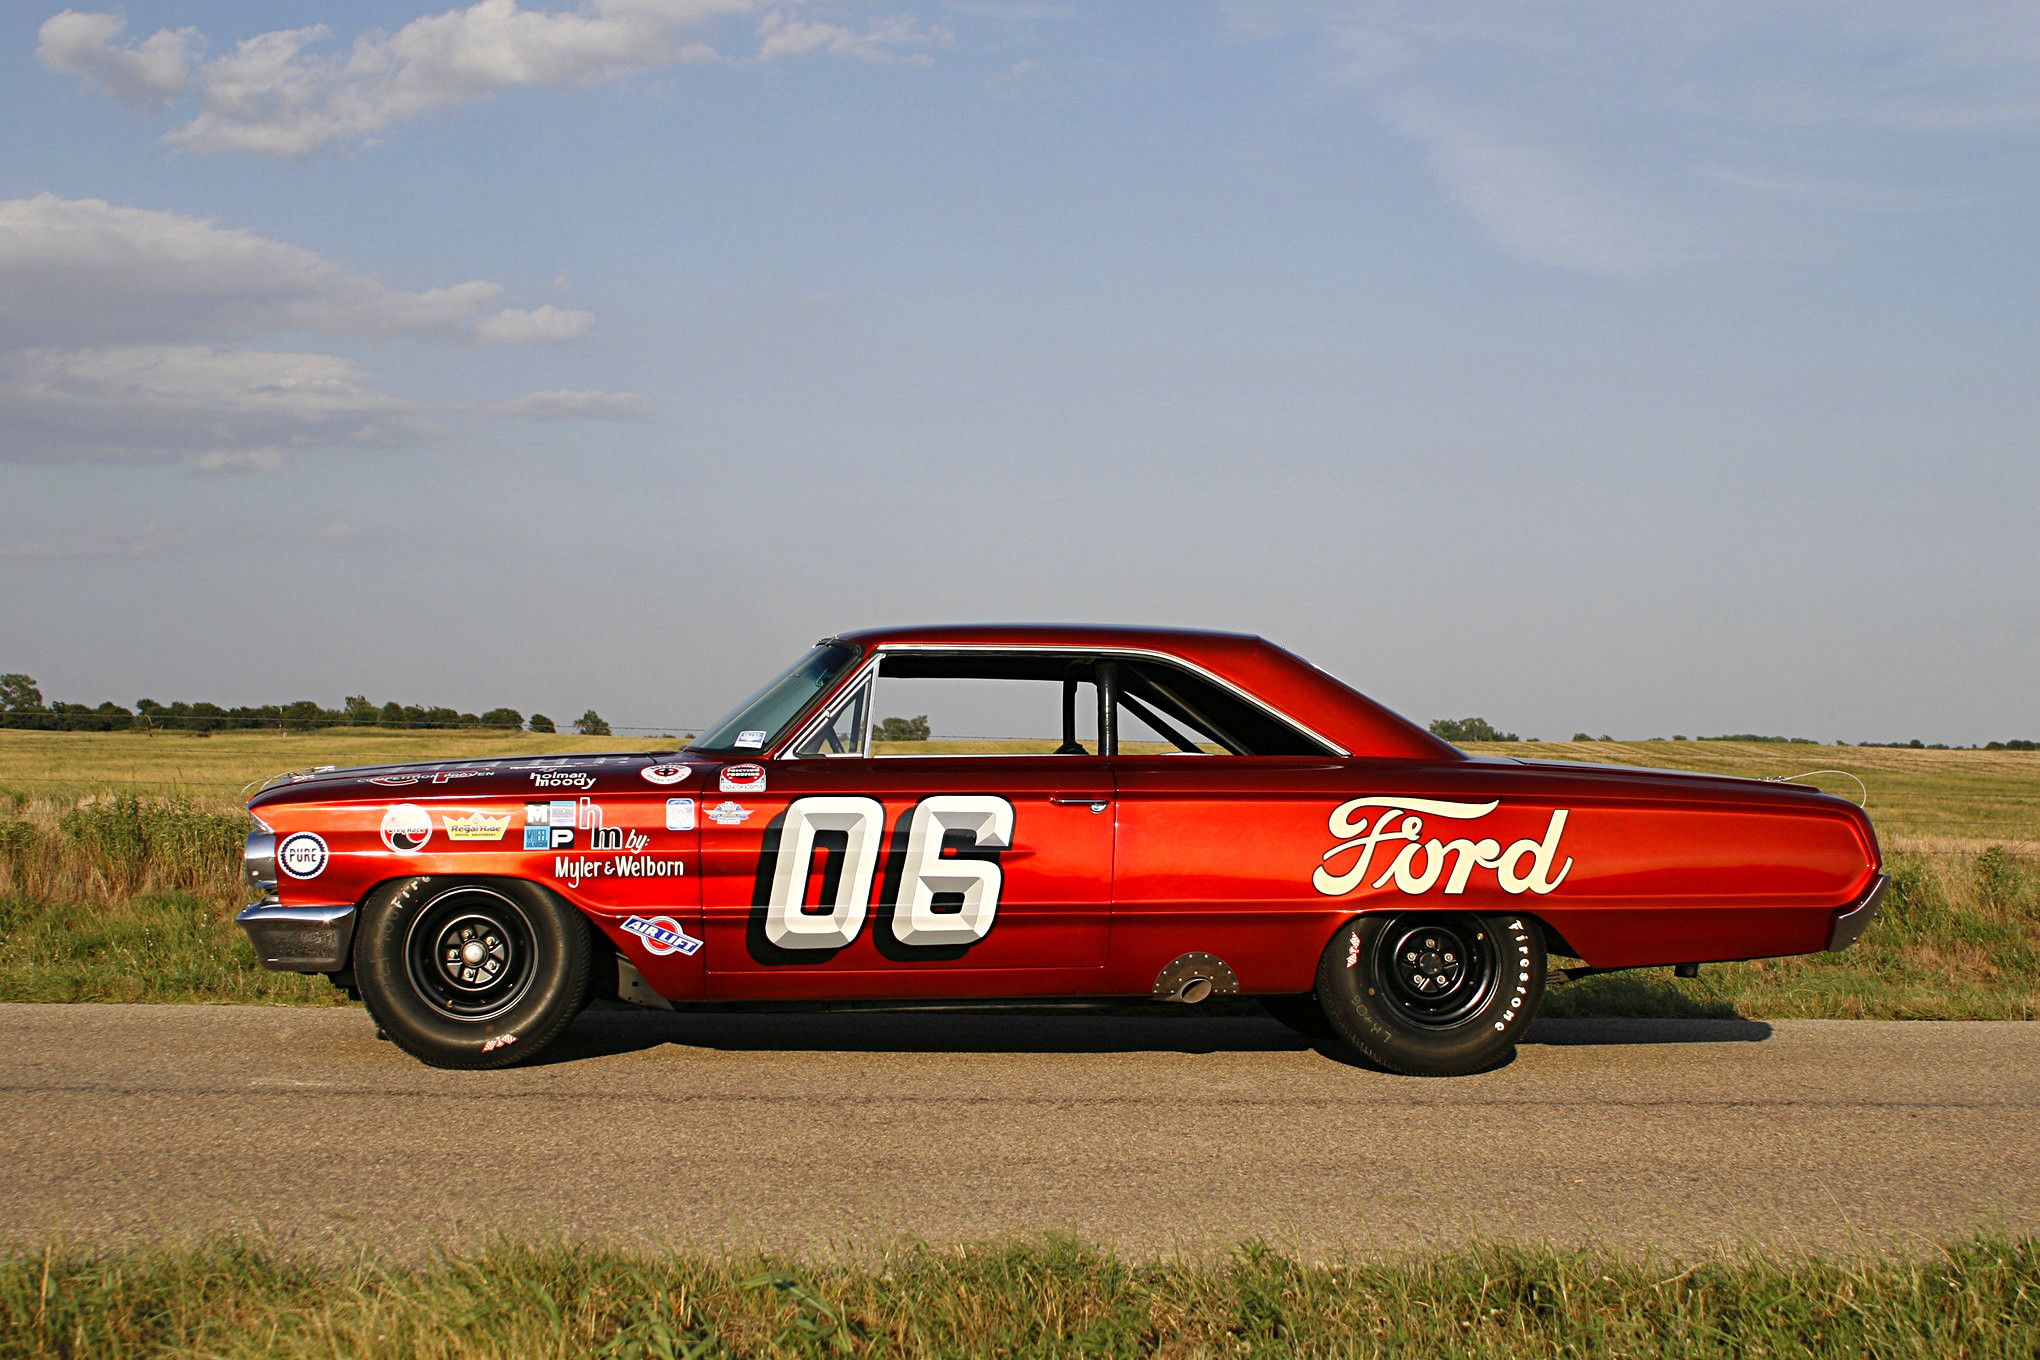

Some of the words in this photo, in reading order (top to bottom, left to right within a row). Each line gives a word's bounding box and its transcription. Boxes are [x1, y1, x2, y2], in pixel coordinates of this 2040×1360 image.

[529, 771, 588, 780] holman
[535, 778, 598, 790] moody
[527, 804, 548, 823] M
[551, 829, 574, 848] P
[1312, 796, 1574, 896] Ford
[290, 848, 317, 862] PURE
[555, 856, 603, 889] Myler
[615, 856, 685, 877] Welborn
[765, 795, 1014, 950] 06
[627, 920, 660, 939] AIR
[658, 931, 697, 951] LIFT
[1494, 919, 1530, 1032] Firestone
